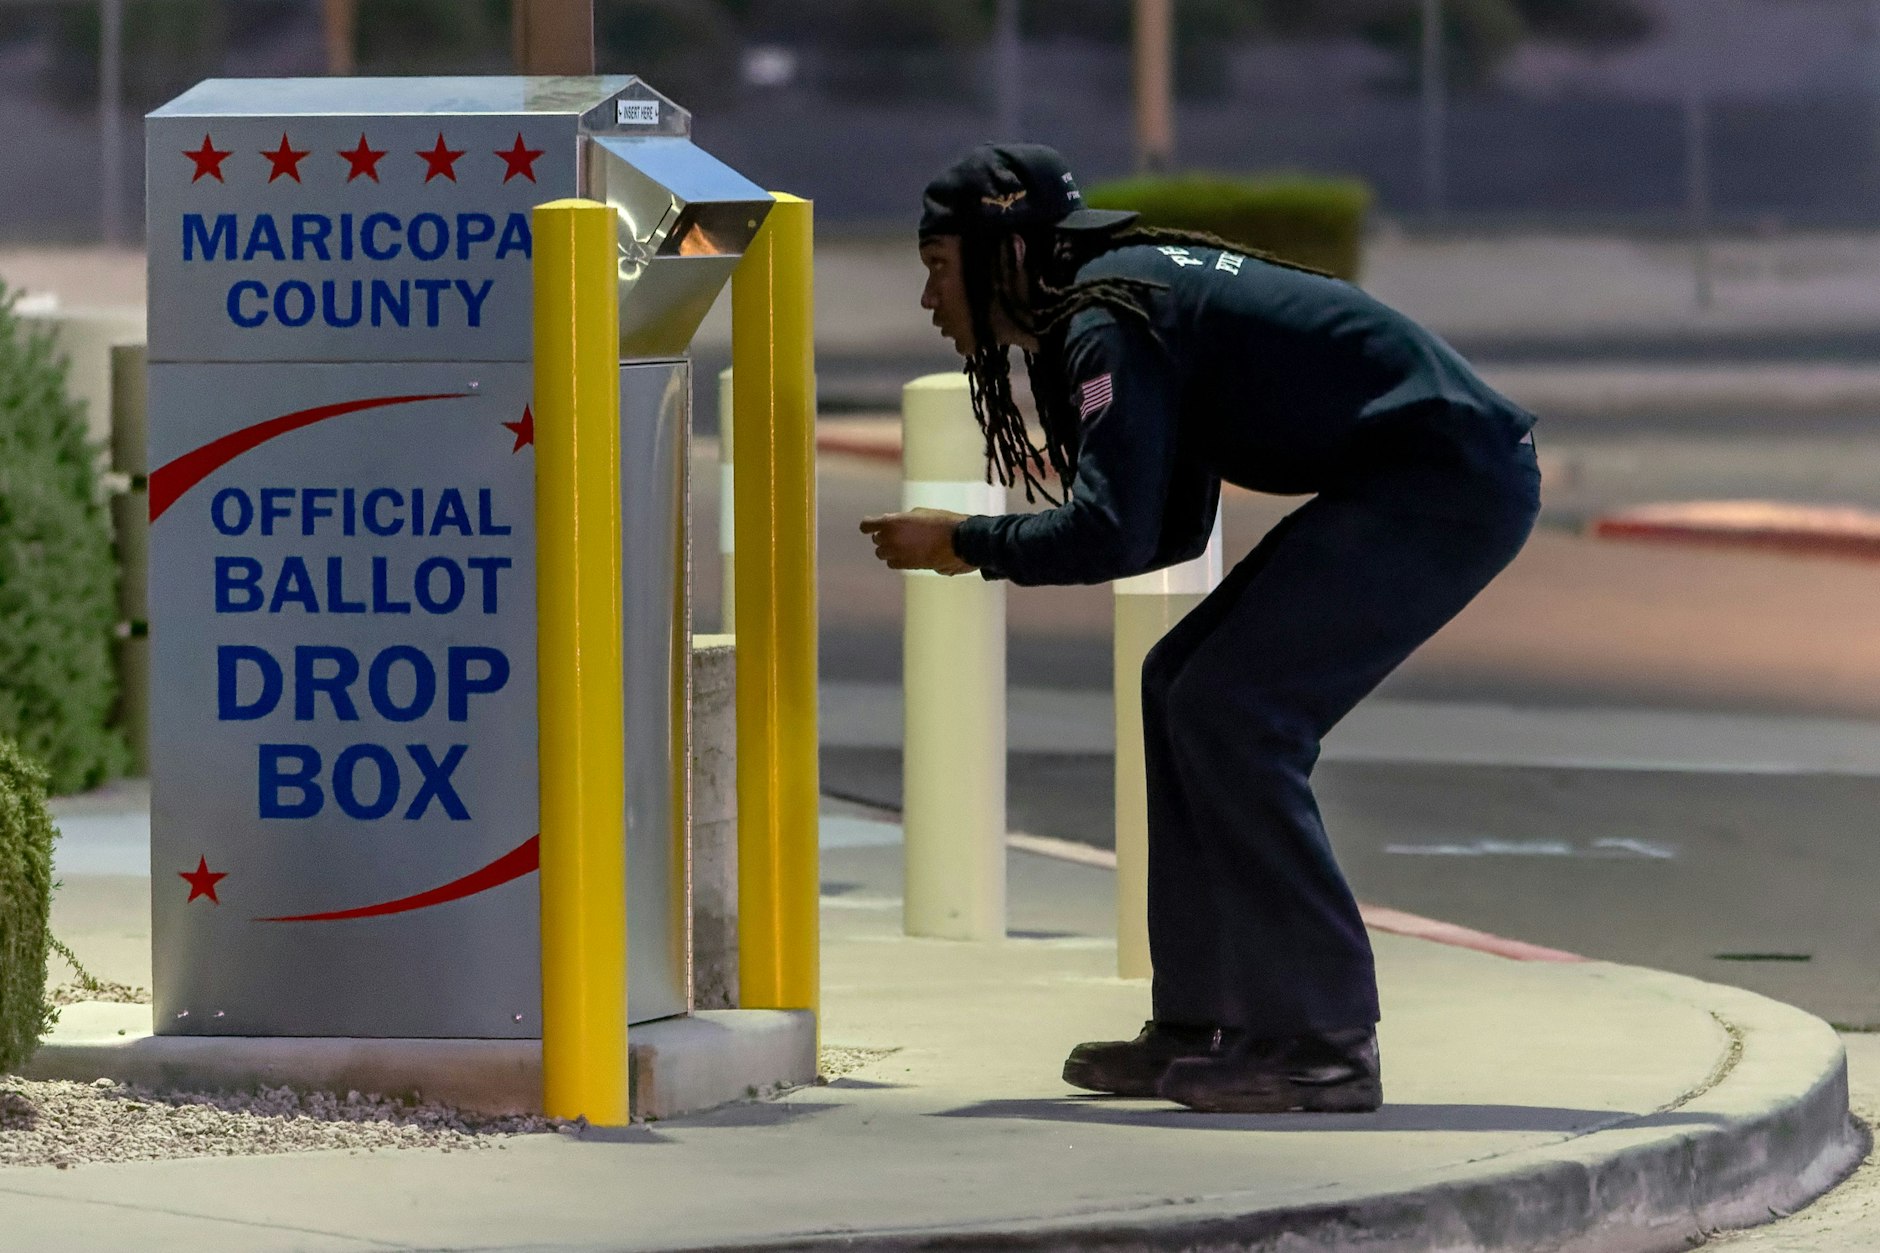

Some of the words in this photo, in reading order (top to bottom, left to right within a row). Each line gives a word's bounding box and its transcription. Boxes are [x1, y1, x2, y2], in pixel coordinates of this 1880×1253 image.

[623, 105, 641, 120] INSERT
[641, 105, 653, 120] HERE
[182, 212, 532, 261] MARICOPA
[226, 279, 494, 328] COUNTY
[210, 487, 512, 537] OFFICIAL
[214, 556, 512, 614] BALLOT
[217, 644, 510, 722] DROP
[258, 743, 472, 821] BOX
